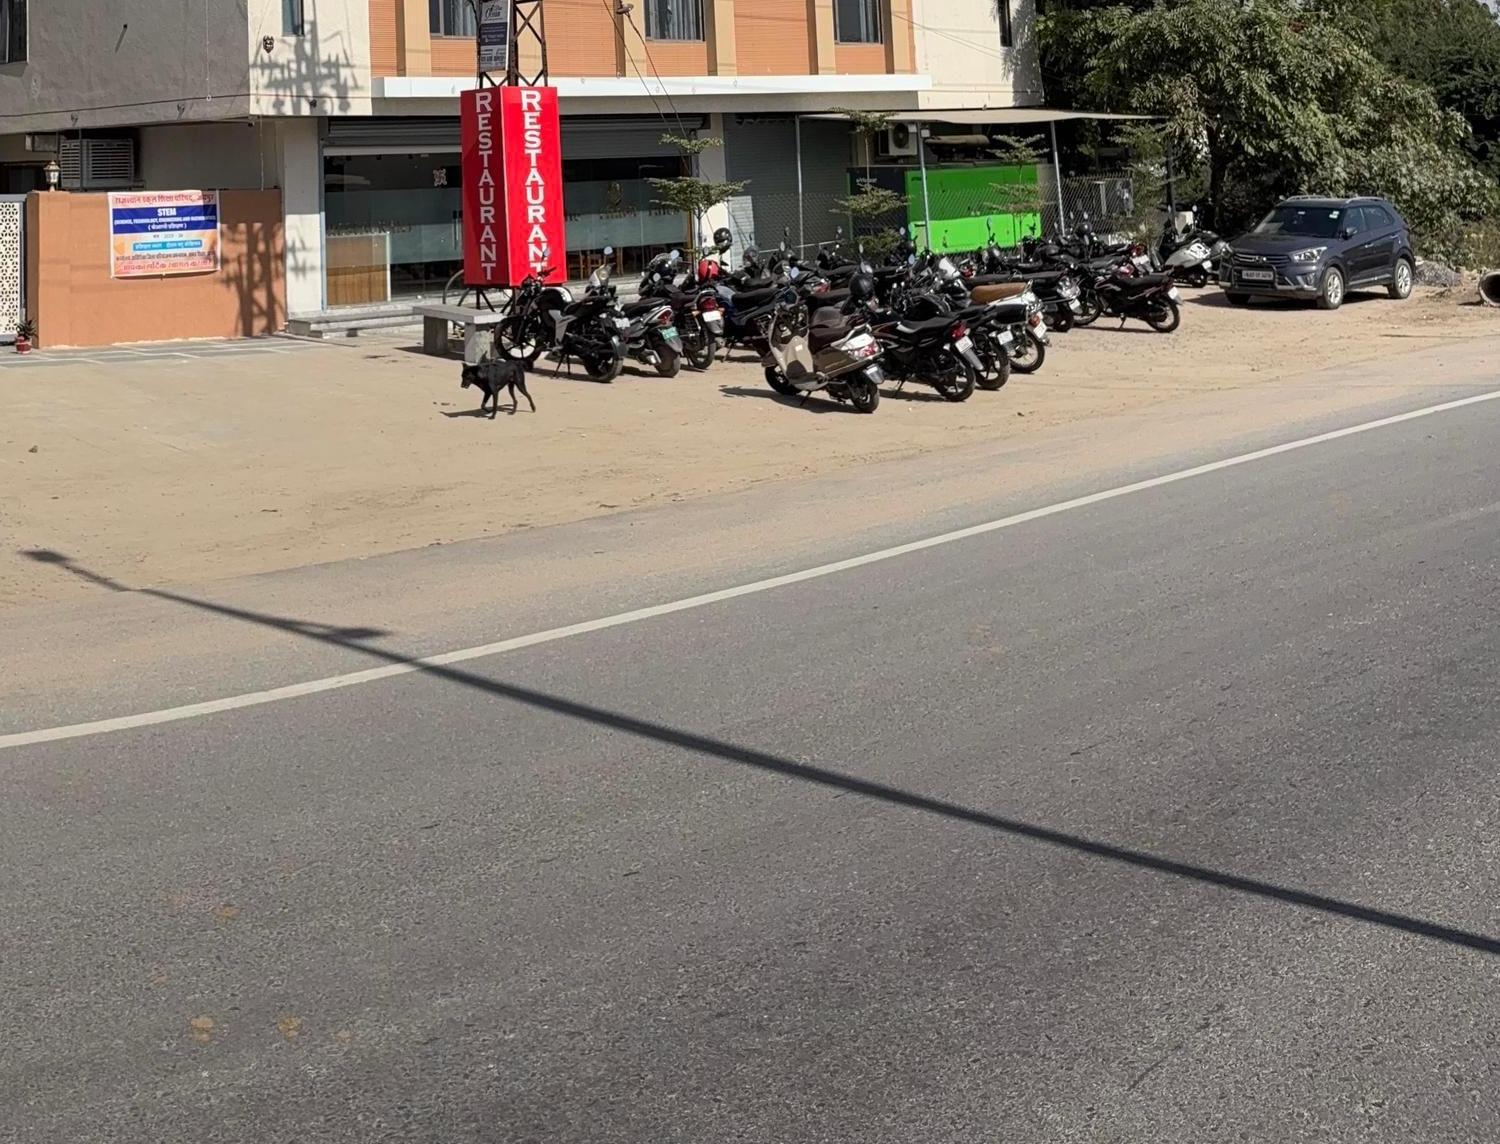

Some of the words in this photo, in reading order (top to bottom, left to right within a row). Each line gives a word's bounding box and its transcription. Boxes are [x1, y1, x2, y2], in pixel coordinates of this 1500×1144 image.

[157, 207, 177, 217] STEM
[474, 91, 498, 281] RESTAURANT
[519, 89, 550, 279] RESTAURANT
